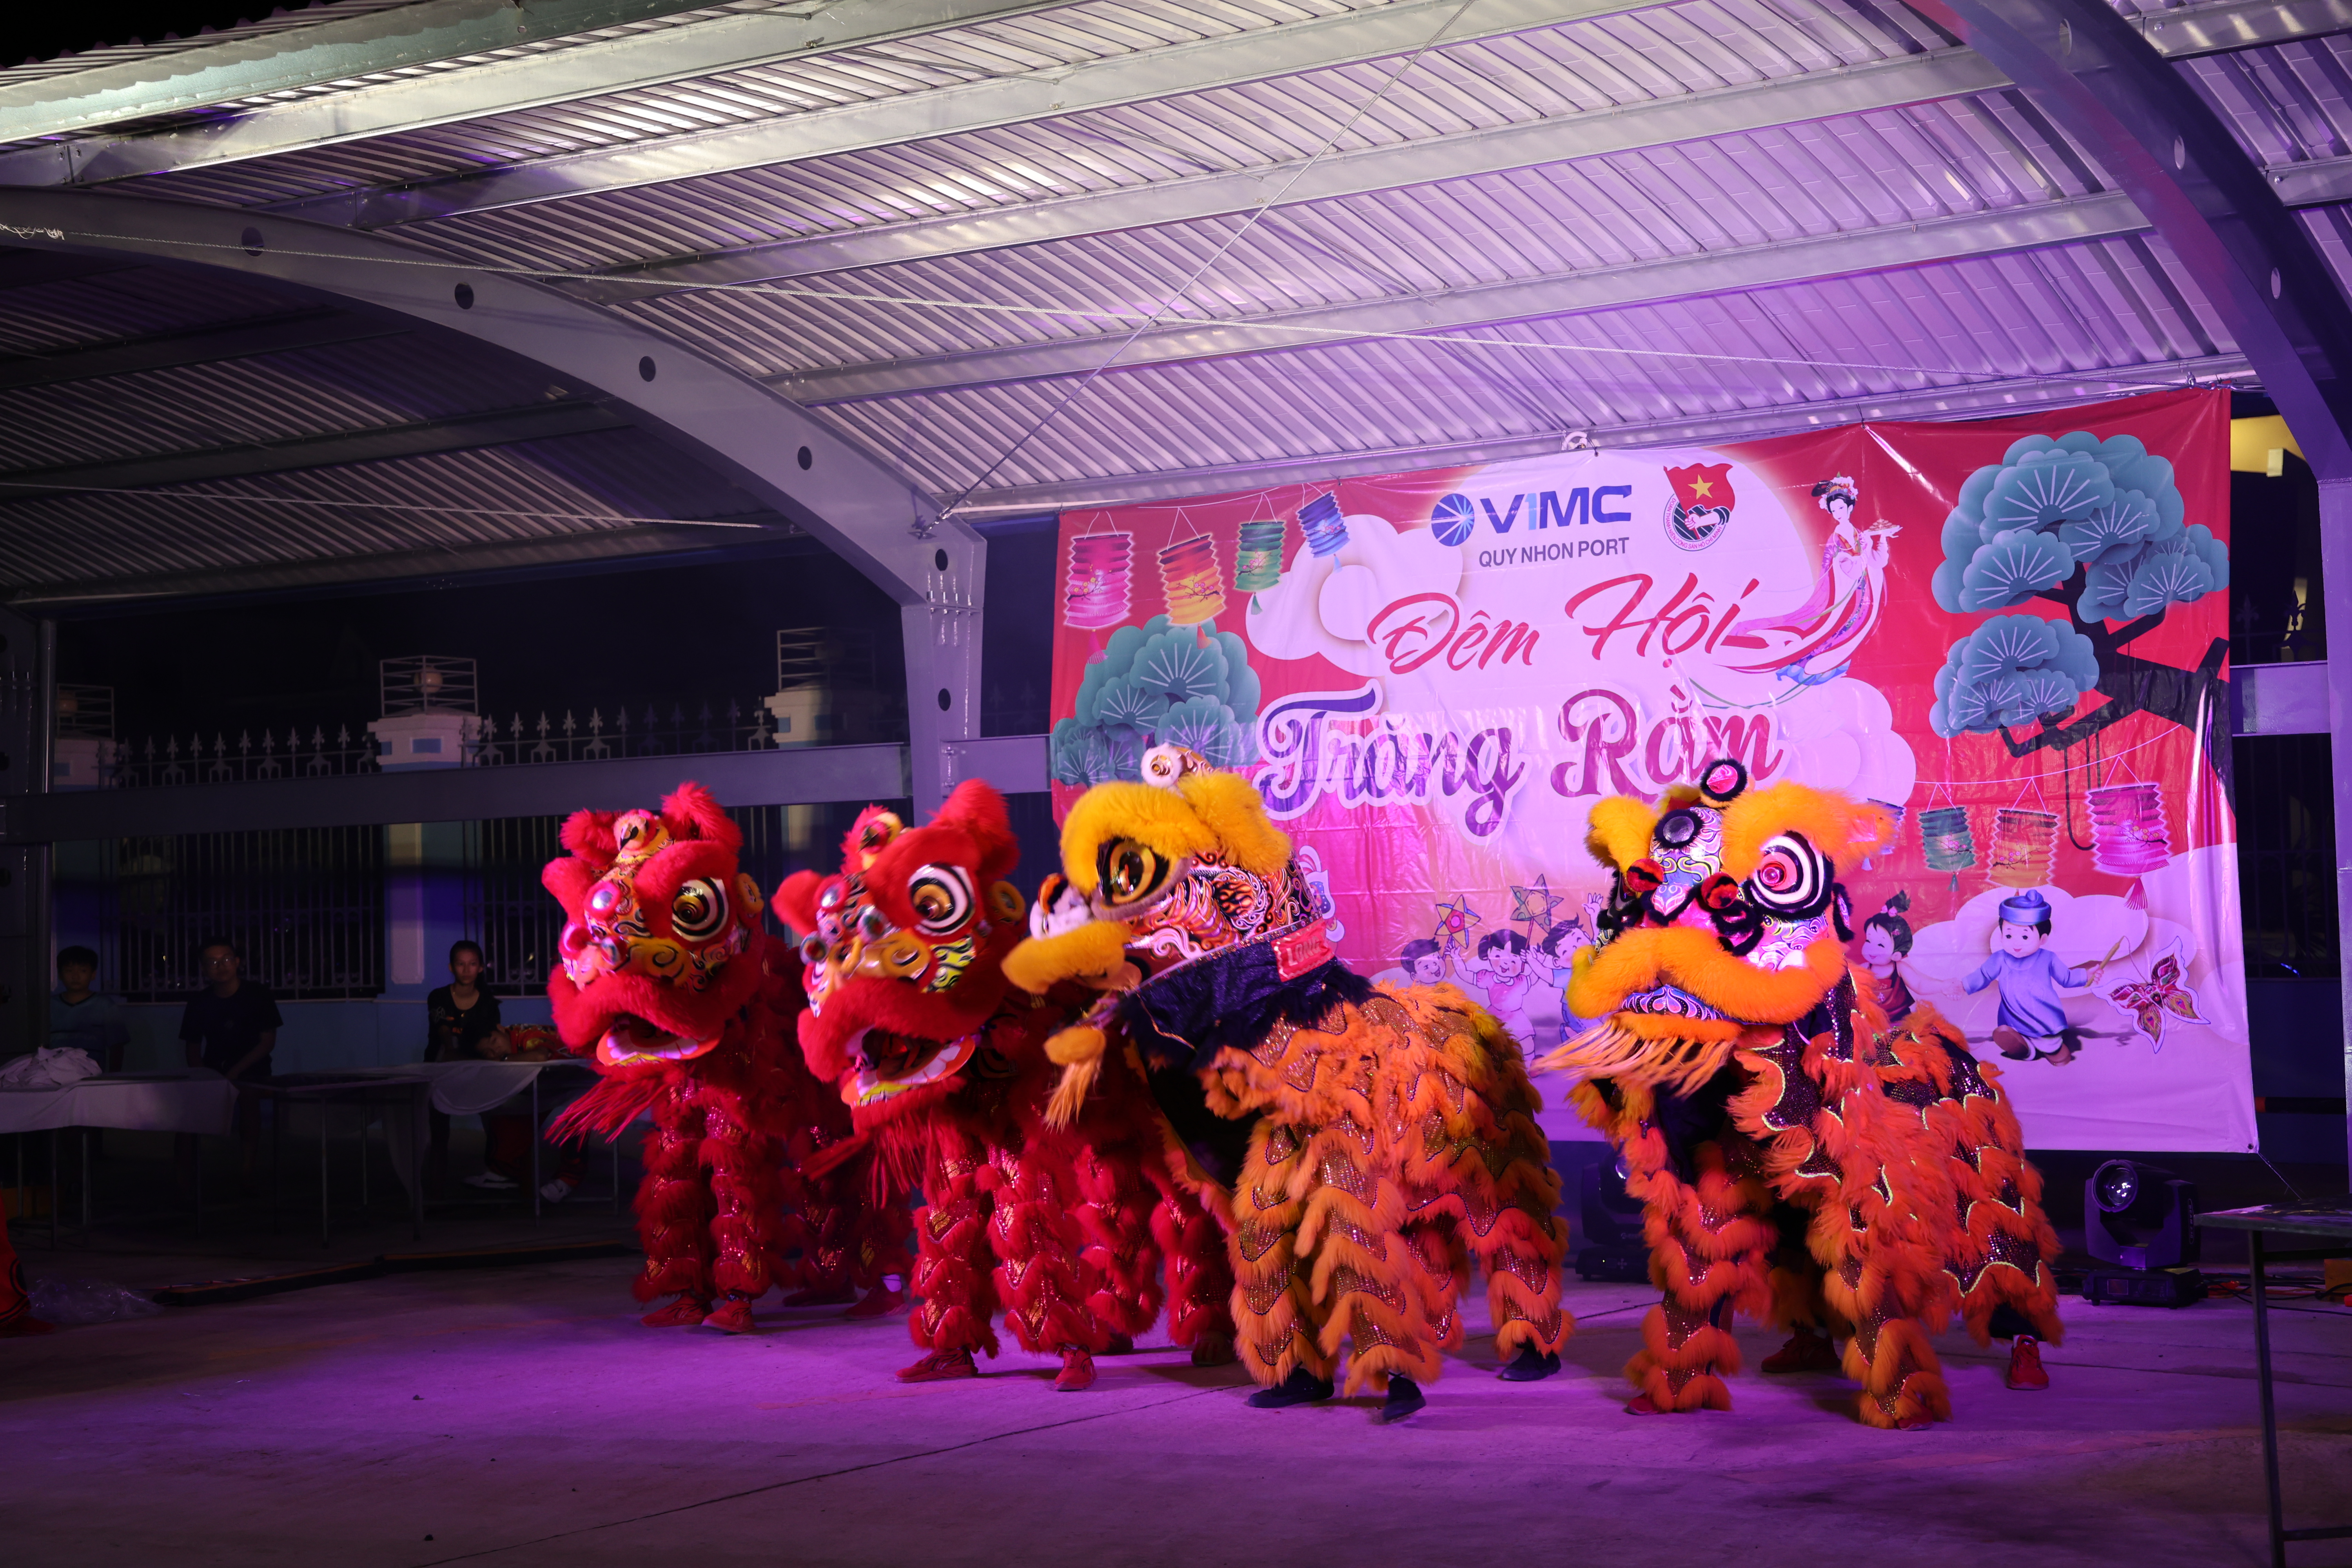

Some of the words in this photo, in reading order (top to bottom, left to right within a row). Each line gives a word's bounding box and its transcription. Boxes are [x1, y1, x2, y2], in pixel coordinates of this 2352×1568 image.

[1479, 548, 1517, 568] QUY
[1521, 542, 1573, 563] NHON
[1579, 537, 1630, 557] PORT
[1712, 526, 1722, 539] MINH
[1366, 592, 1540, 675] Đêm
[1564, 572, 1769, 668] Hội
[1258, 687, 1526, 837] Trăng
[1550, 684, 1784, 803] Rằm
